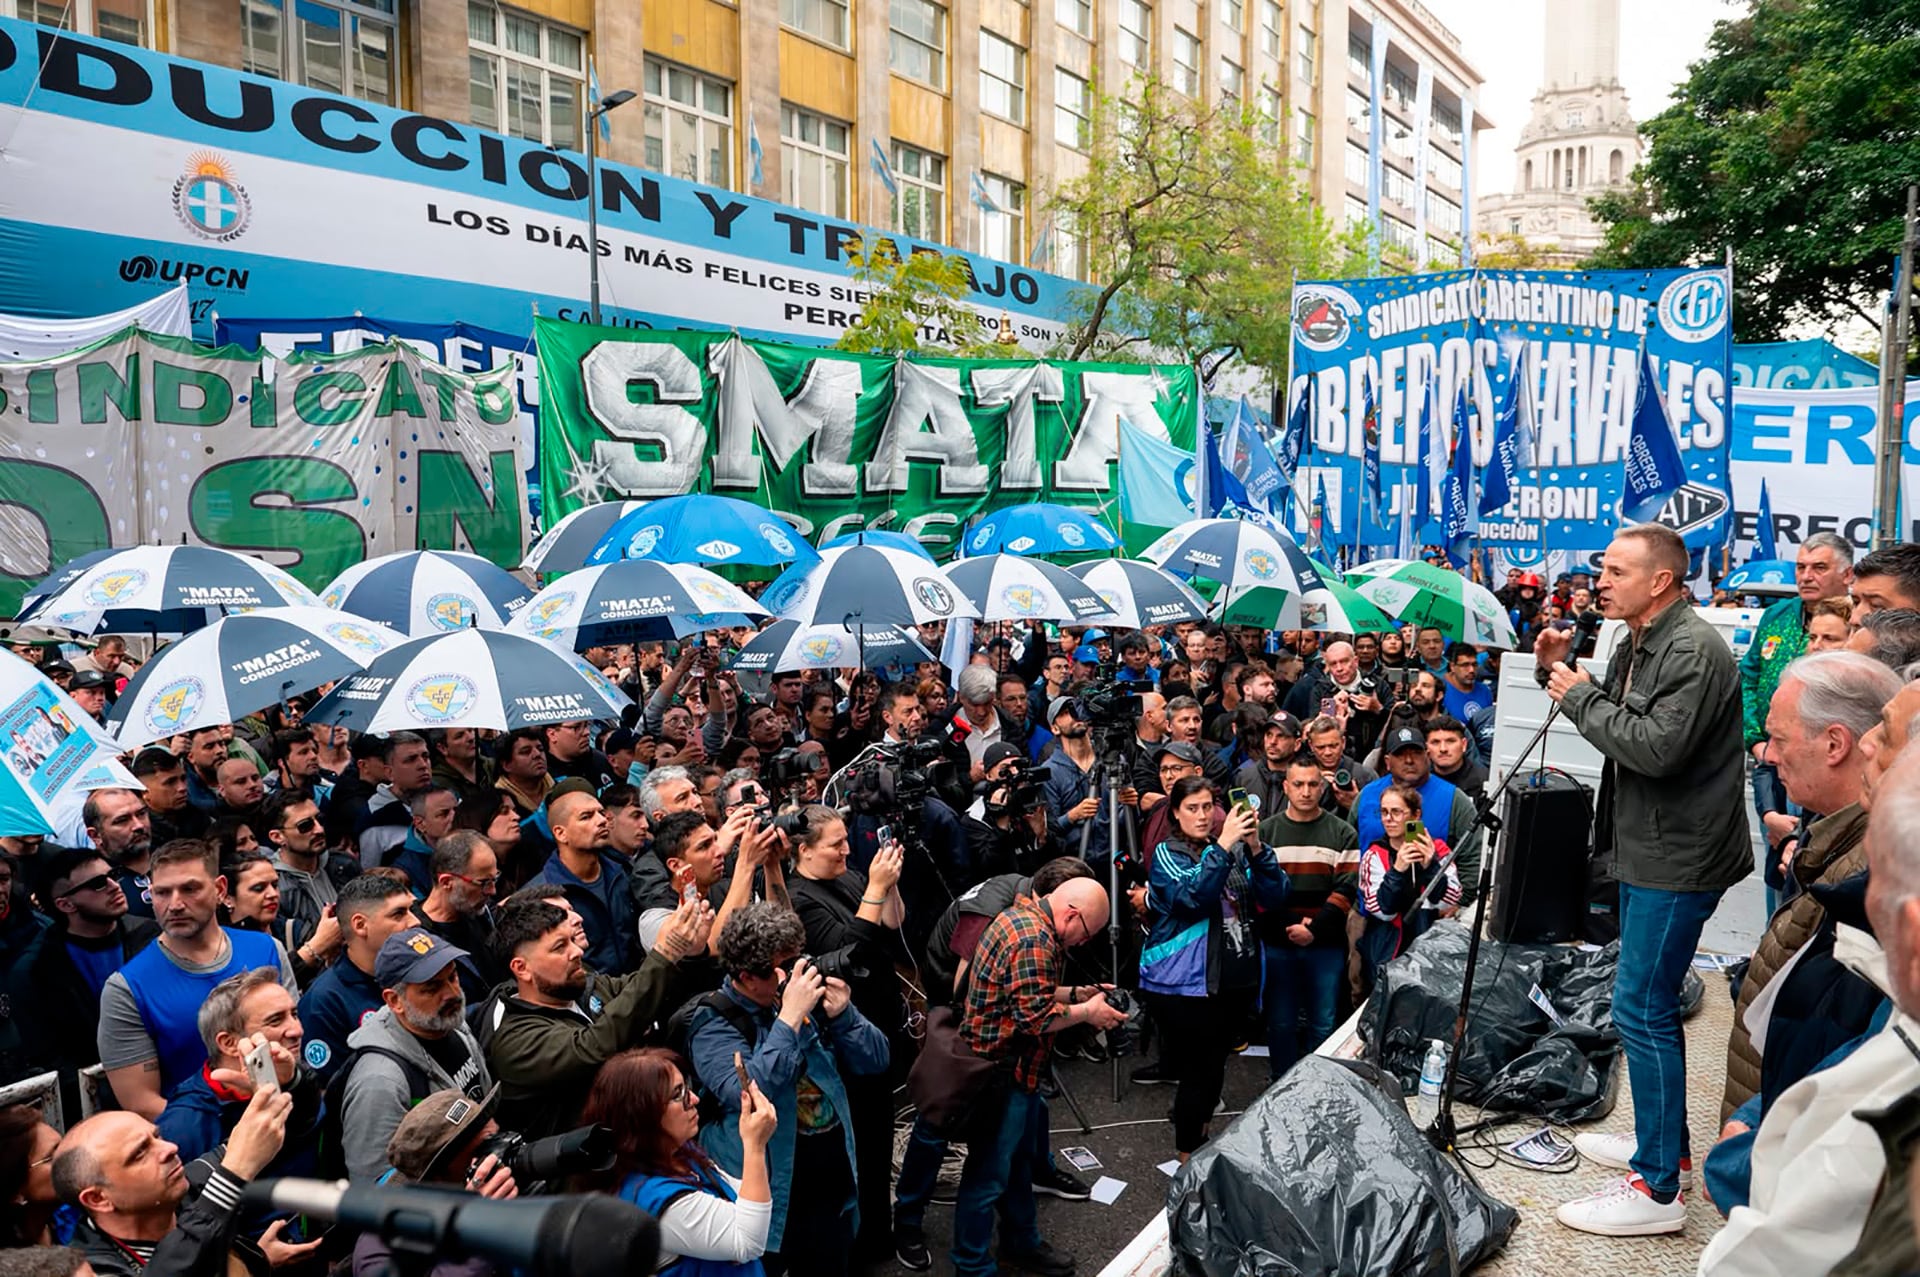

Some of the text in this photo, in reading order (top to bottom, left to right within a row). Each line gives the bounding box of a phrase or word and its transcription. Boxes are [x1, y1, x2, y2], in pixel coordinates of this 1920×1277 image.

[0, 28, 661, 222] DUCCIÓN
[694, 191, 748, 239] Y
[160, 260, 248, 289] UPCN
[427, 204, 510, 235] LOS
[526, 224, 611, 257] DÍAS
[624, 246, 693, 274] MÁS
[705, 263, 821, 296] FELICES
[1021, 325, 1050, 341] SON
[1368, 279, 1649, 340] SINDICATO ARGENTINO DE
[1672, 279, 1722, 327] CGT
[0, 353, 514, 427] INDICATO
[579, 339, 1172, 499] SMATA
[1632, 434, 1662, 489] OBREROS
[1658, 490, 1710, 526] ATT
[1479, 520, 1539, 541] UCCIÓN
[178, 586, 255, 598] "MATA"
[600, 595, 672, 611] "MATA"
[1145, 602, 1185, 616] "MATA"
[601, 605, 675, 619] CONDUCCIÓN
[232, 639, 311, 673] "MATA"
[239, 649, 322, 685] CONDUCCIÓN
[515, 693, 584, 711] "MATA"
[523, 707, 593, 721] CONDUCCIÓN
